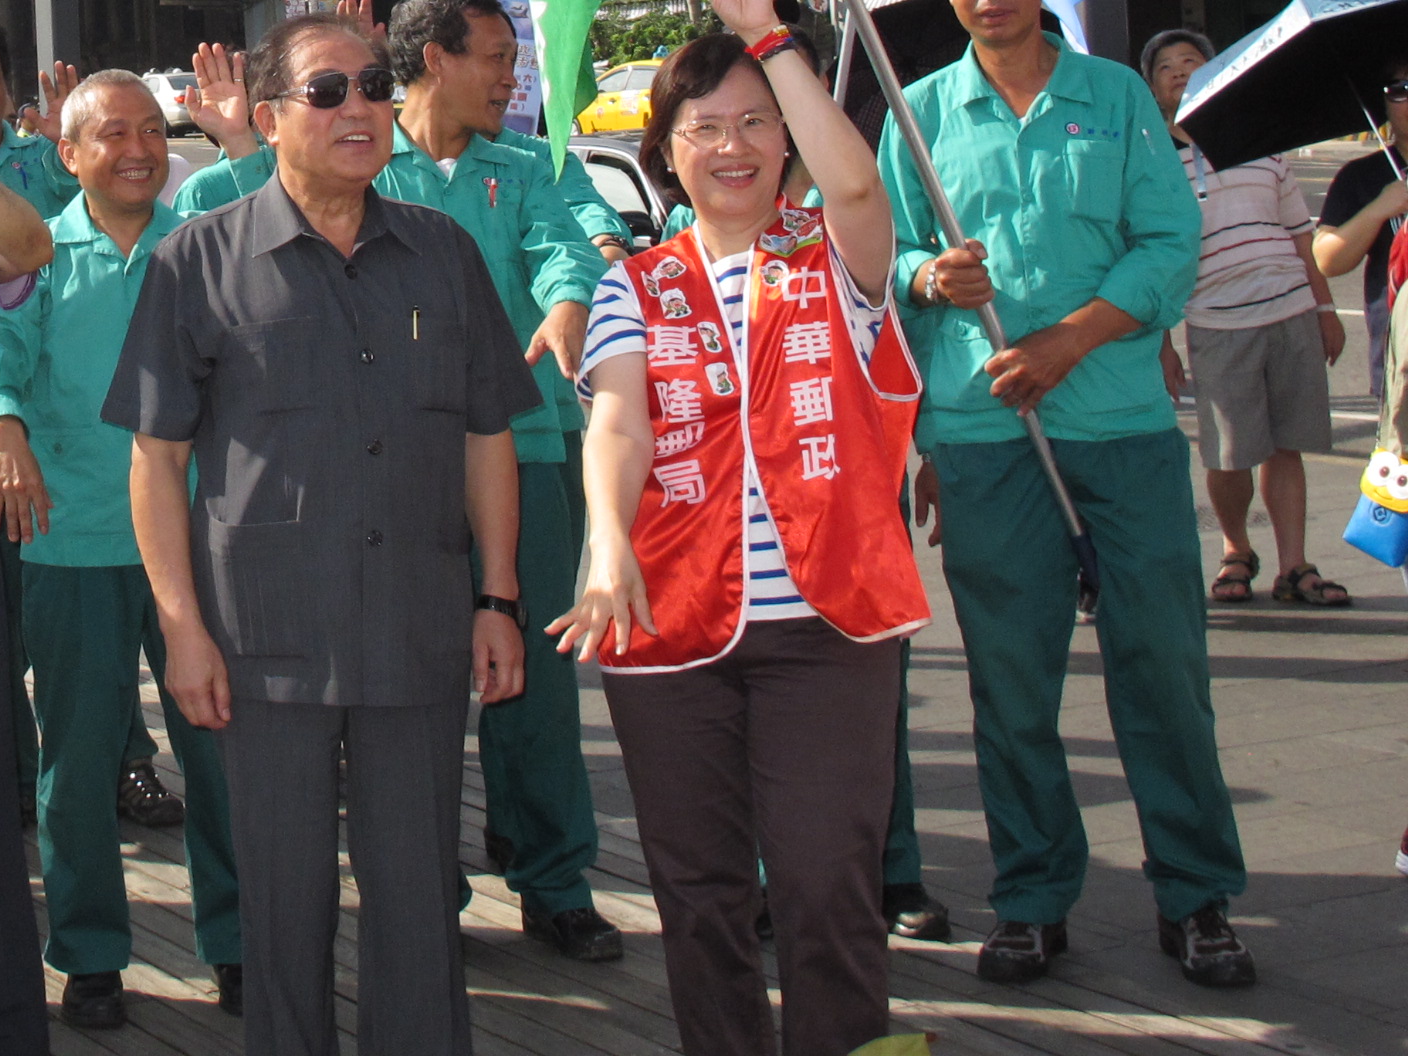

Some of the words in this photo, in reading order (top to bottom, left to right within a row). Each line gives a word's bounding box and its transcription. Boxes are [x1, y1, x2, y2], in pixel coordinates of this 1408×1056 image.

[647, 324, 706, 508] 基隆郵局
[782, 265, 842, 481] 中華郵政
